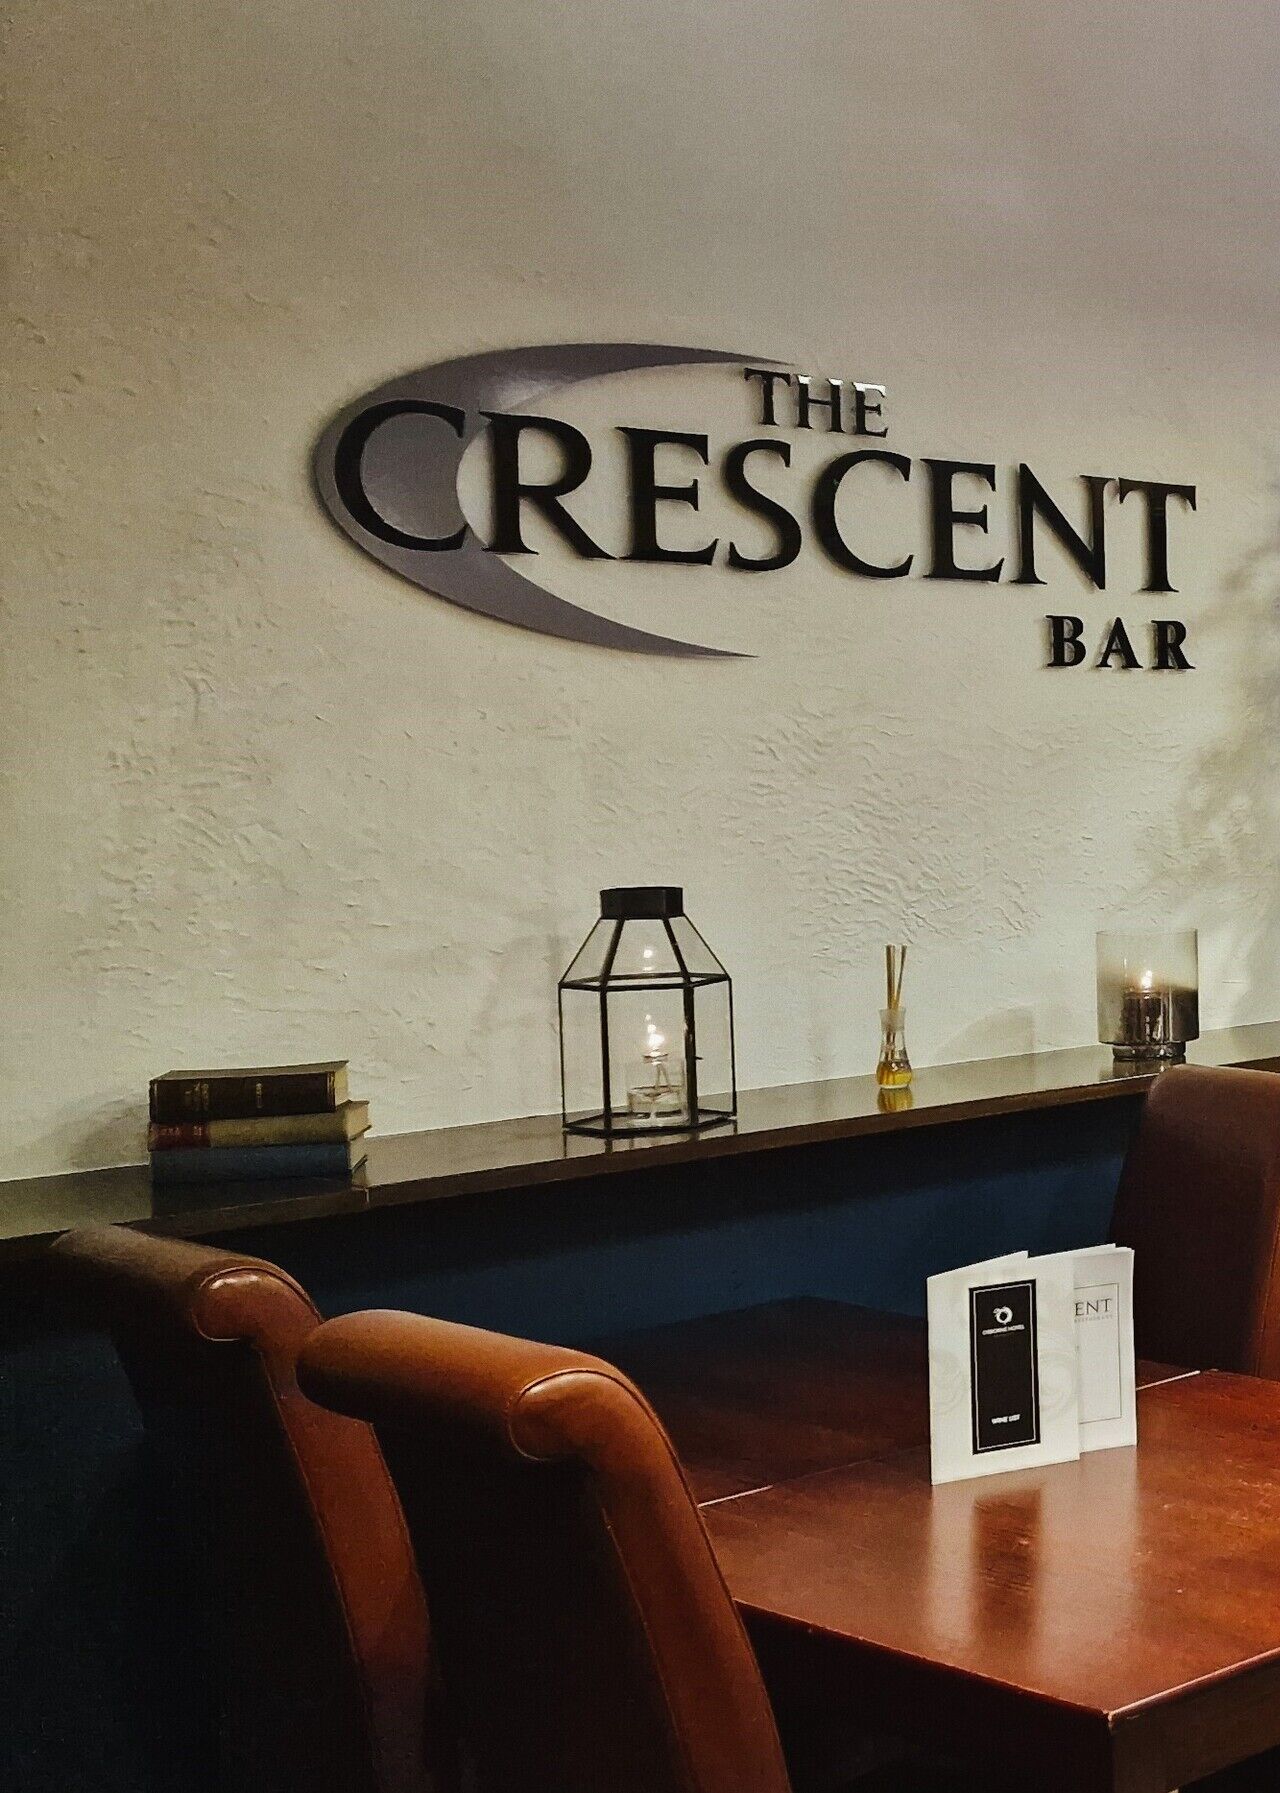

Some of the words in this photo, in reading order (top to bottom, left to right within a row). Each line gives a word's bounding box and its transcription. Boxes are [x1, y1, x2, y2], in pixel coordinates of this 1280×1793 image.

[742, 366, 889, 439] THE
[334, 399, 1198, 593] CRESCENT
[1045, 614, 1196, 671] BAR
[1074, 1298, 1113, 1317] ENT
